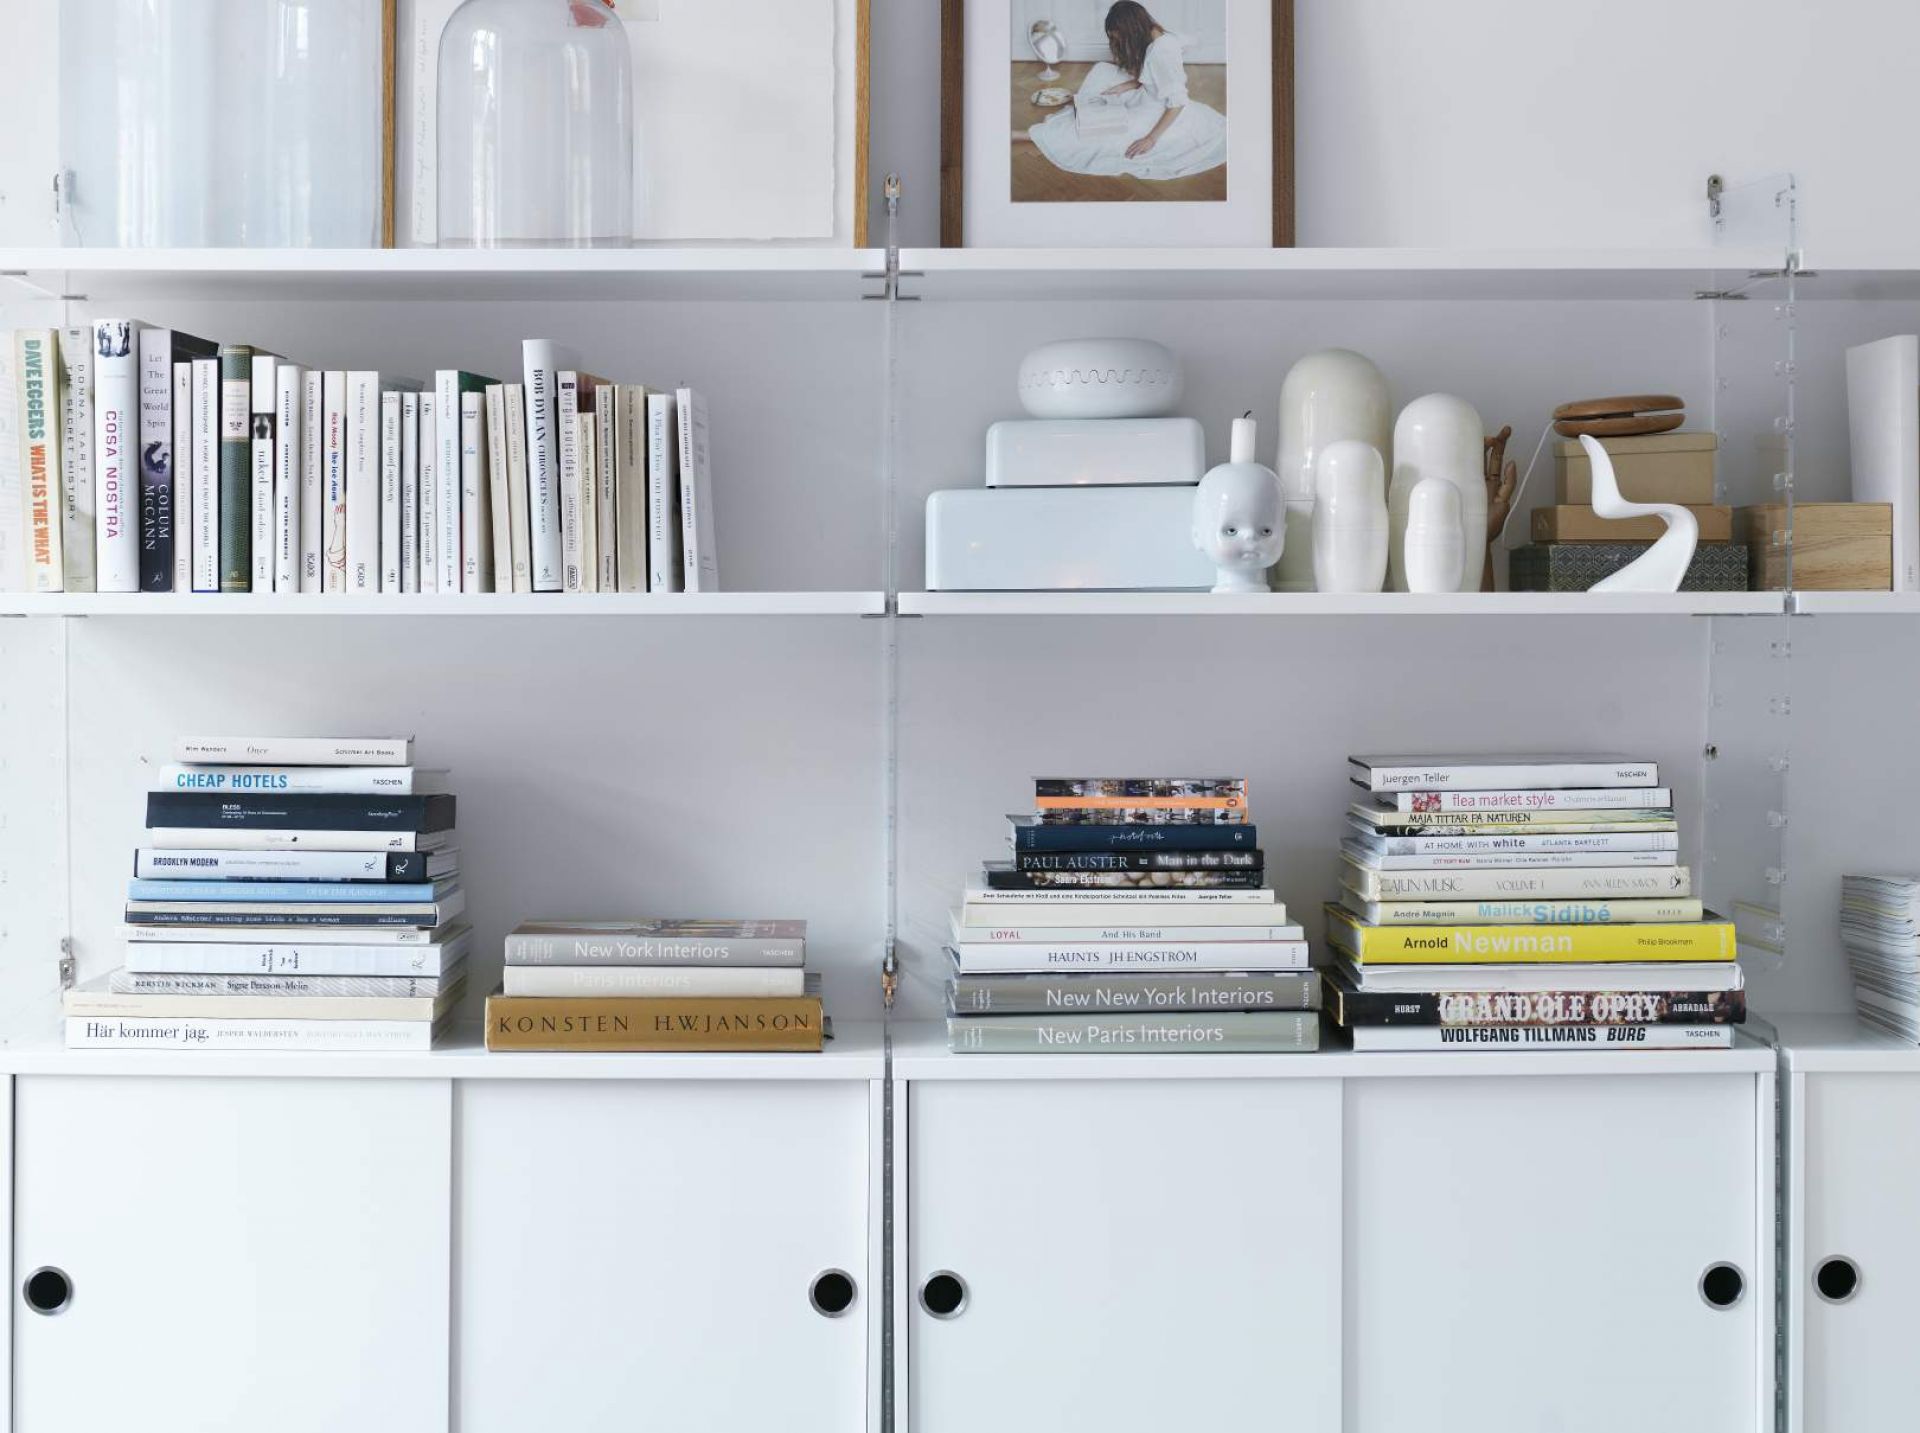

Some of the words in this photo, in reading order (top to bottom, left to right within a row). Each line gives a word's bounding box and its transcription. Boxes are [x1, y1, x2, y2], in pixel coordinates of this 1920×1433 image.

[25, 339, 43, 379] DAVE
[149, 355, 162, 363] Let
[148, 370, 165, 379] The
[533, 369, 545, 394] BOB
[78, 364, 86, 417] DONNA
[144, 387, 168, 395] Great
[27, 380, 45, 439] EGGERS
[143, 402, 169, 411] World
[147, 419, 167, 429] Spin
[329, 412, 339, 425] Rick
[534, 398, 546, 441] DYLAN
[106, 410, 118, 457] COSA
[328, 426, 339, 448] Moody
[30, 444, 47, 482] WHAT
[79, 432, 87, 485] TARTT
[258, 450, 270, 484] naked
[331, 451, 339, 465] the
[331, 465, 339, 478] ice
[537, 444, 549, 504] CHRONICLES
[32, 484, 48, 498] IS
[68, 460, 76, 521] HISTORY
[331, 479, 339, 502] storm
[32, 499, 49, 525] THE
[105, 467, 118, 539] NOSTRA
[158, 484, 170, 539] COLUM
[145, 484, 157, 550] McCANN
[33, 526, 51, 565] WHAT
[307, 552, 315, 578] PICADOR
[356, 562, 365, 588] PICADOR
[177, 773, 226, 788] CHEAP
[231, 774, 287, 788] HOTELS
[372, 778, 403, 786] TASCHEN
[1382, 772, 1421, 786] Juergen
[1422, 771, 1450, 784] Teller
[1615, 769, 1648, 779] TASCHEN
[1452, 793, 1476, 807] flea
[1478, 793, 1523, 807] market
[1525, 793, 1555, 808] style
[1407, 813, 1434, 825] MAJA
[1434, 813, 1469, 824] TITTAR
[1486, 811, 1531, 823] NATUREN
[1424, 841, 1437, 849] AT
[1437, 840, 1464, 849] HOME
[1465, 840, 1490, 848] WITH
[1491, 837, 1526, 849] white
[1540, 838, 1572, 846] ATLANTA
[1573, 837, 1609, 846] BARTLETT
[153, 857, 188, 867] BROOKLYN
[189, 857, 219, 867] MODERN
[1022, 855, 1063, 868] PAUL
[1065, 855, 1128, 868] AUSTER
[1156, 853, 1184, 866] Man
[1186, 854, 1198, 866] in
[1200, 853, 1220, 866] the
[1222, 853, 1252, 866] Dark
[1423, 877, 1464, 892] MUSIC
[1419, 909, 1456, 920] Magnin
[1478, 903, 1532, 918] Malick
[1532, 902, 1611, 924] Sidibé
[990, 930, 1022, 939] LOYAL
[1101, 929, 1121, 939] And
[1122, 929, 1137, 938] His
[1140, 929, 1162, 938] Band
[1403, 936, 1449, 950] Arnold
[1454, 932, 1573, 953] Newman
[1637, 937, 1658, 948] Philip
[1658, 937, 1693, 947] Brookman
[574, 940, 614, 959] New
[615, 940, 654, 960] York
[658, 941, 729, 960] Interiors
[1047, 951, 1100, 963] HAUNTS
[1108, 951, 1124, 964] JH
[226, 980, 250, 992] Signe
[573, 969, 614, 987] Paris
[620, 969, 690, 987] Interiors
[1046, 988, 1091, 1006] New
[1095, 988, 1140, 1005] New
[1143, 986, 1187, 1005] York
[1191, 985, 1275, 1004] Interiors
[1394, 1003, 1421, 1014] HURST
[1437, 994, 1532, 1022] GRAND
[1534, 994, 1587, 1022] OLE
[1590, 994, 1660, 1022] OPRY
[86, 1022, 115, 1039] Här
[118, 1022, 180, 1039] kommer
[181, 1022, 210, 1043] jag.
[499, 1015, 630, 1033] KONSTEN
[1037, 1026, 1082, 1044] New
[1087, 1024, 1136, 1043] Paris
[1141, 1022, 1225, 1042] Interiors
[1440, 1026, 1520, 1044] WOLFGANG
[1523, 1026, 1597, 1043] TILLMANS
[1605, 1026, 1647, 1042] BURG
[1684, 1028, 1722, 1038] TASCHEN
